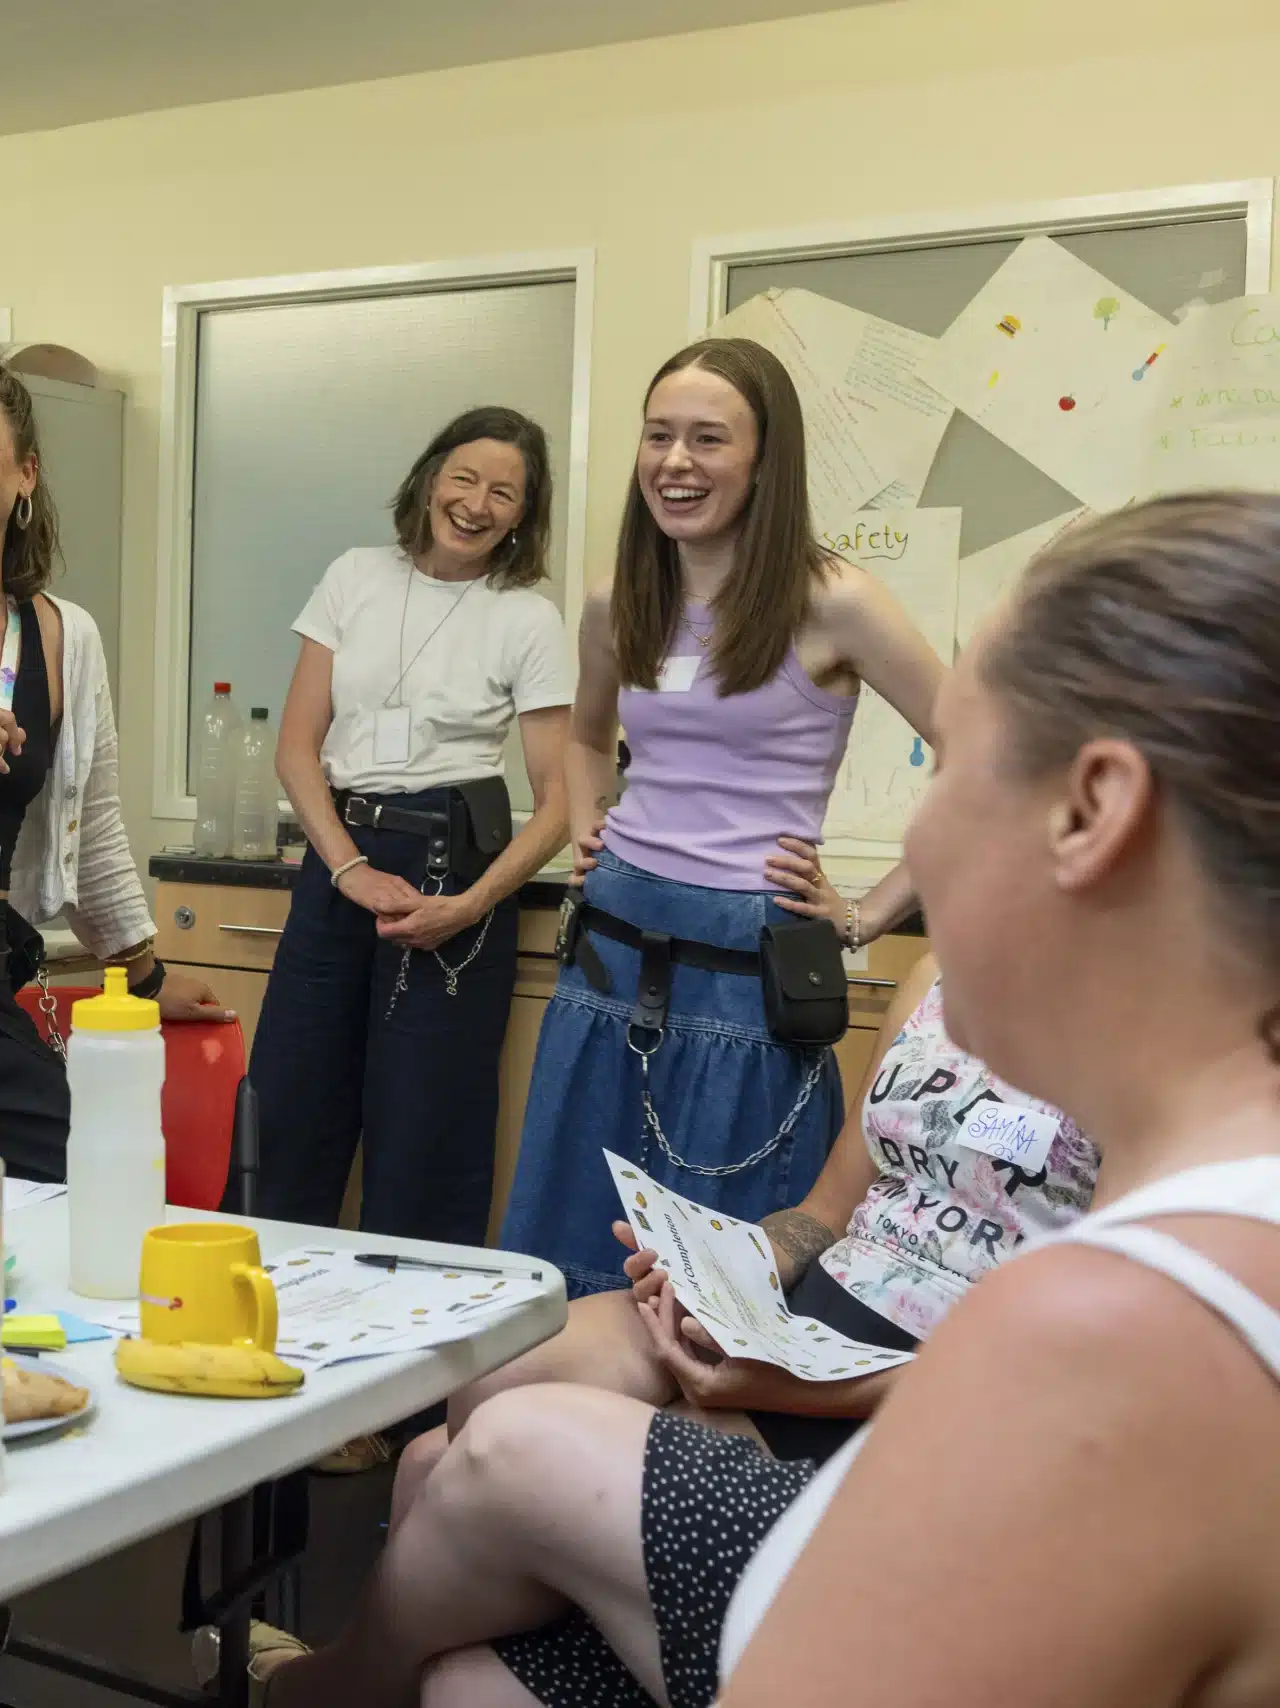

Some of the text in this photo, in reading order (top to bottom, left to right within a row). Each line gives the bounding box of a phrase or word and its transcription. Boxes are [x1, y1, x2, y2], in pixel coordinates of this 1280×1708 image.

[879, 1136, 960, 1189] DRY
[663, 1213, 696, 1281] Completion
[875, 1213, 920, 1246] TOKYO
